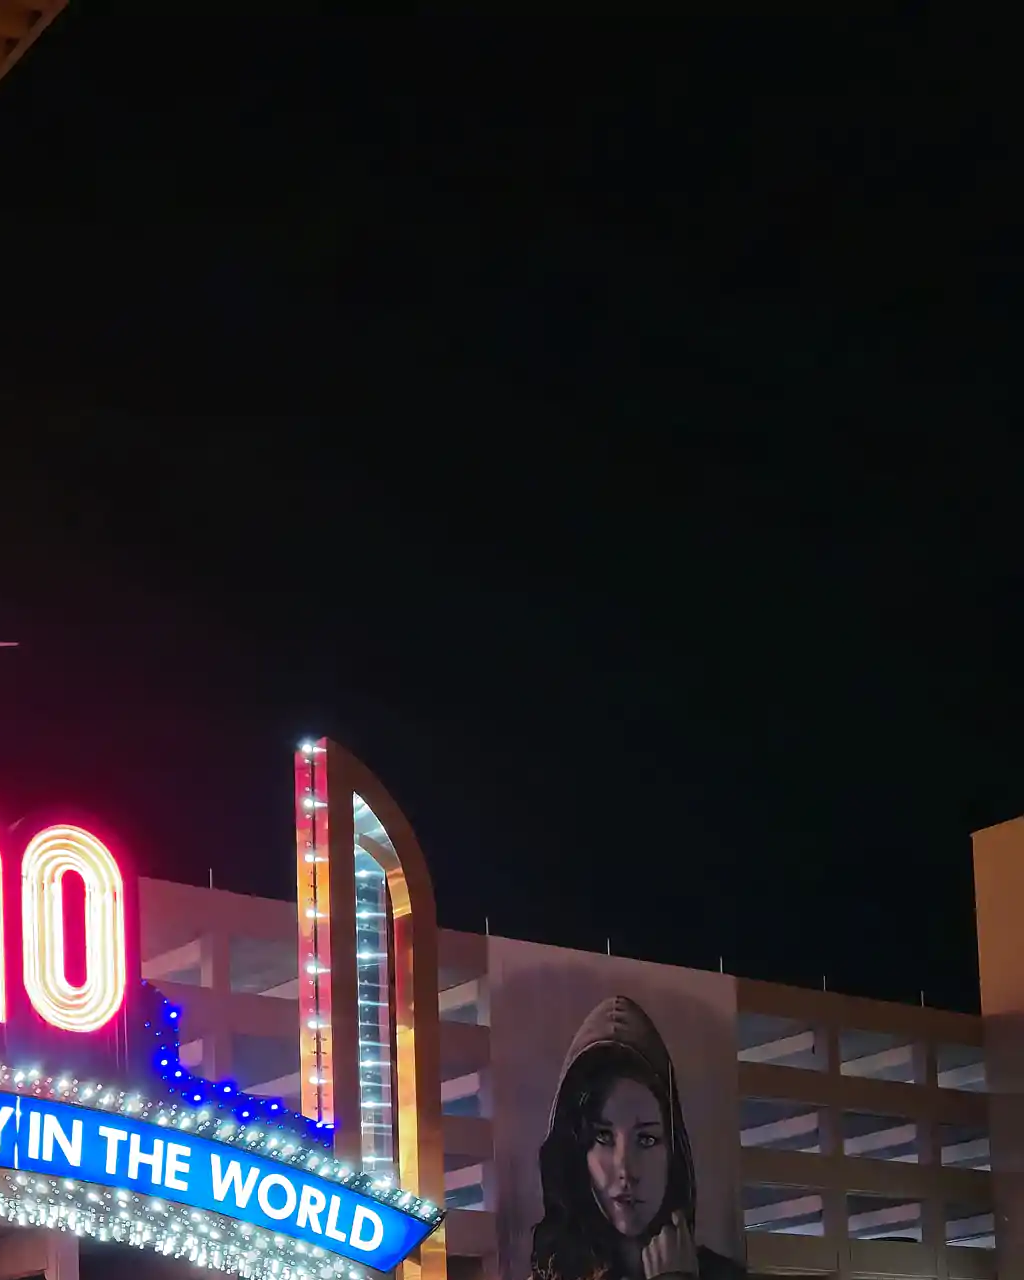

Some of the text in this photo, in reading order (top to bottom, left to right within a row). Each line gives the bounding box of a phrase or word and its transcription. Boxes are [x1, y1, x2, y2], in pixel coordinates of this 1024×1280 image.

[28, 1111, 83, 1167] IN
[98, 1126, 192, 1192] THE
[210, 1153, 384, 1252] WORLD
